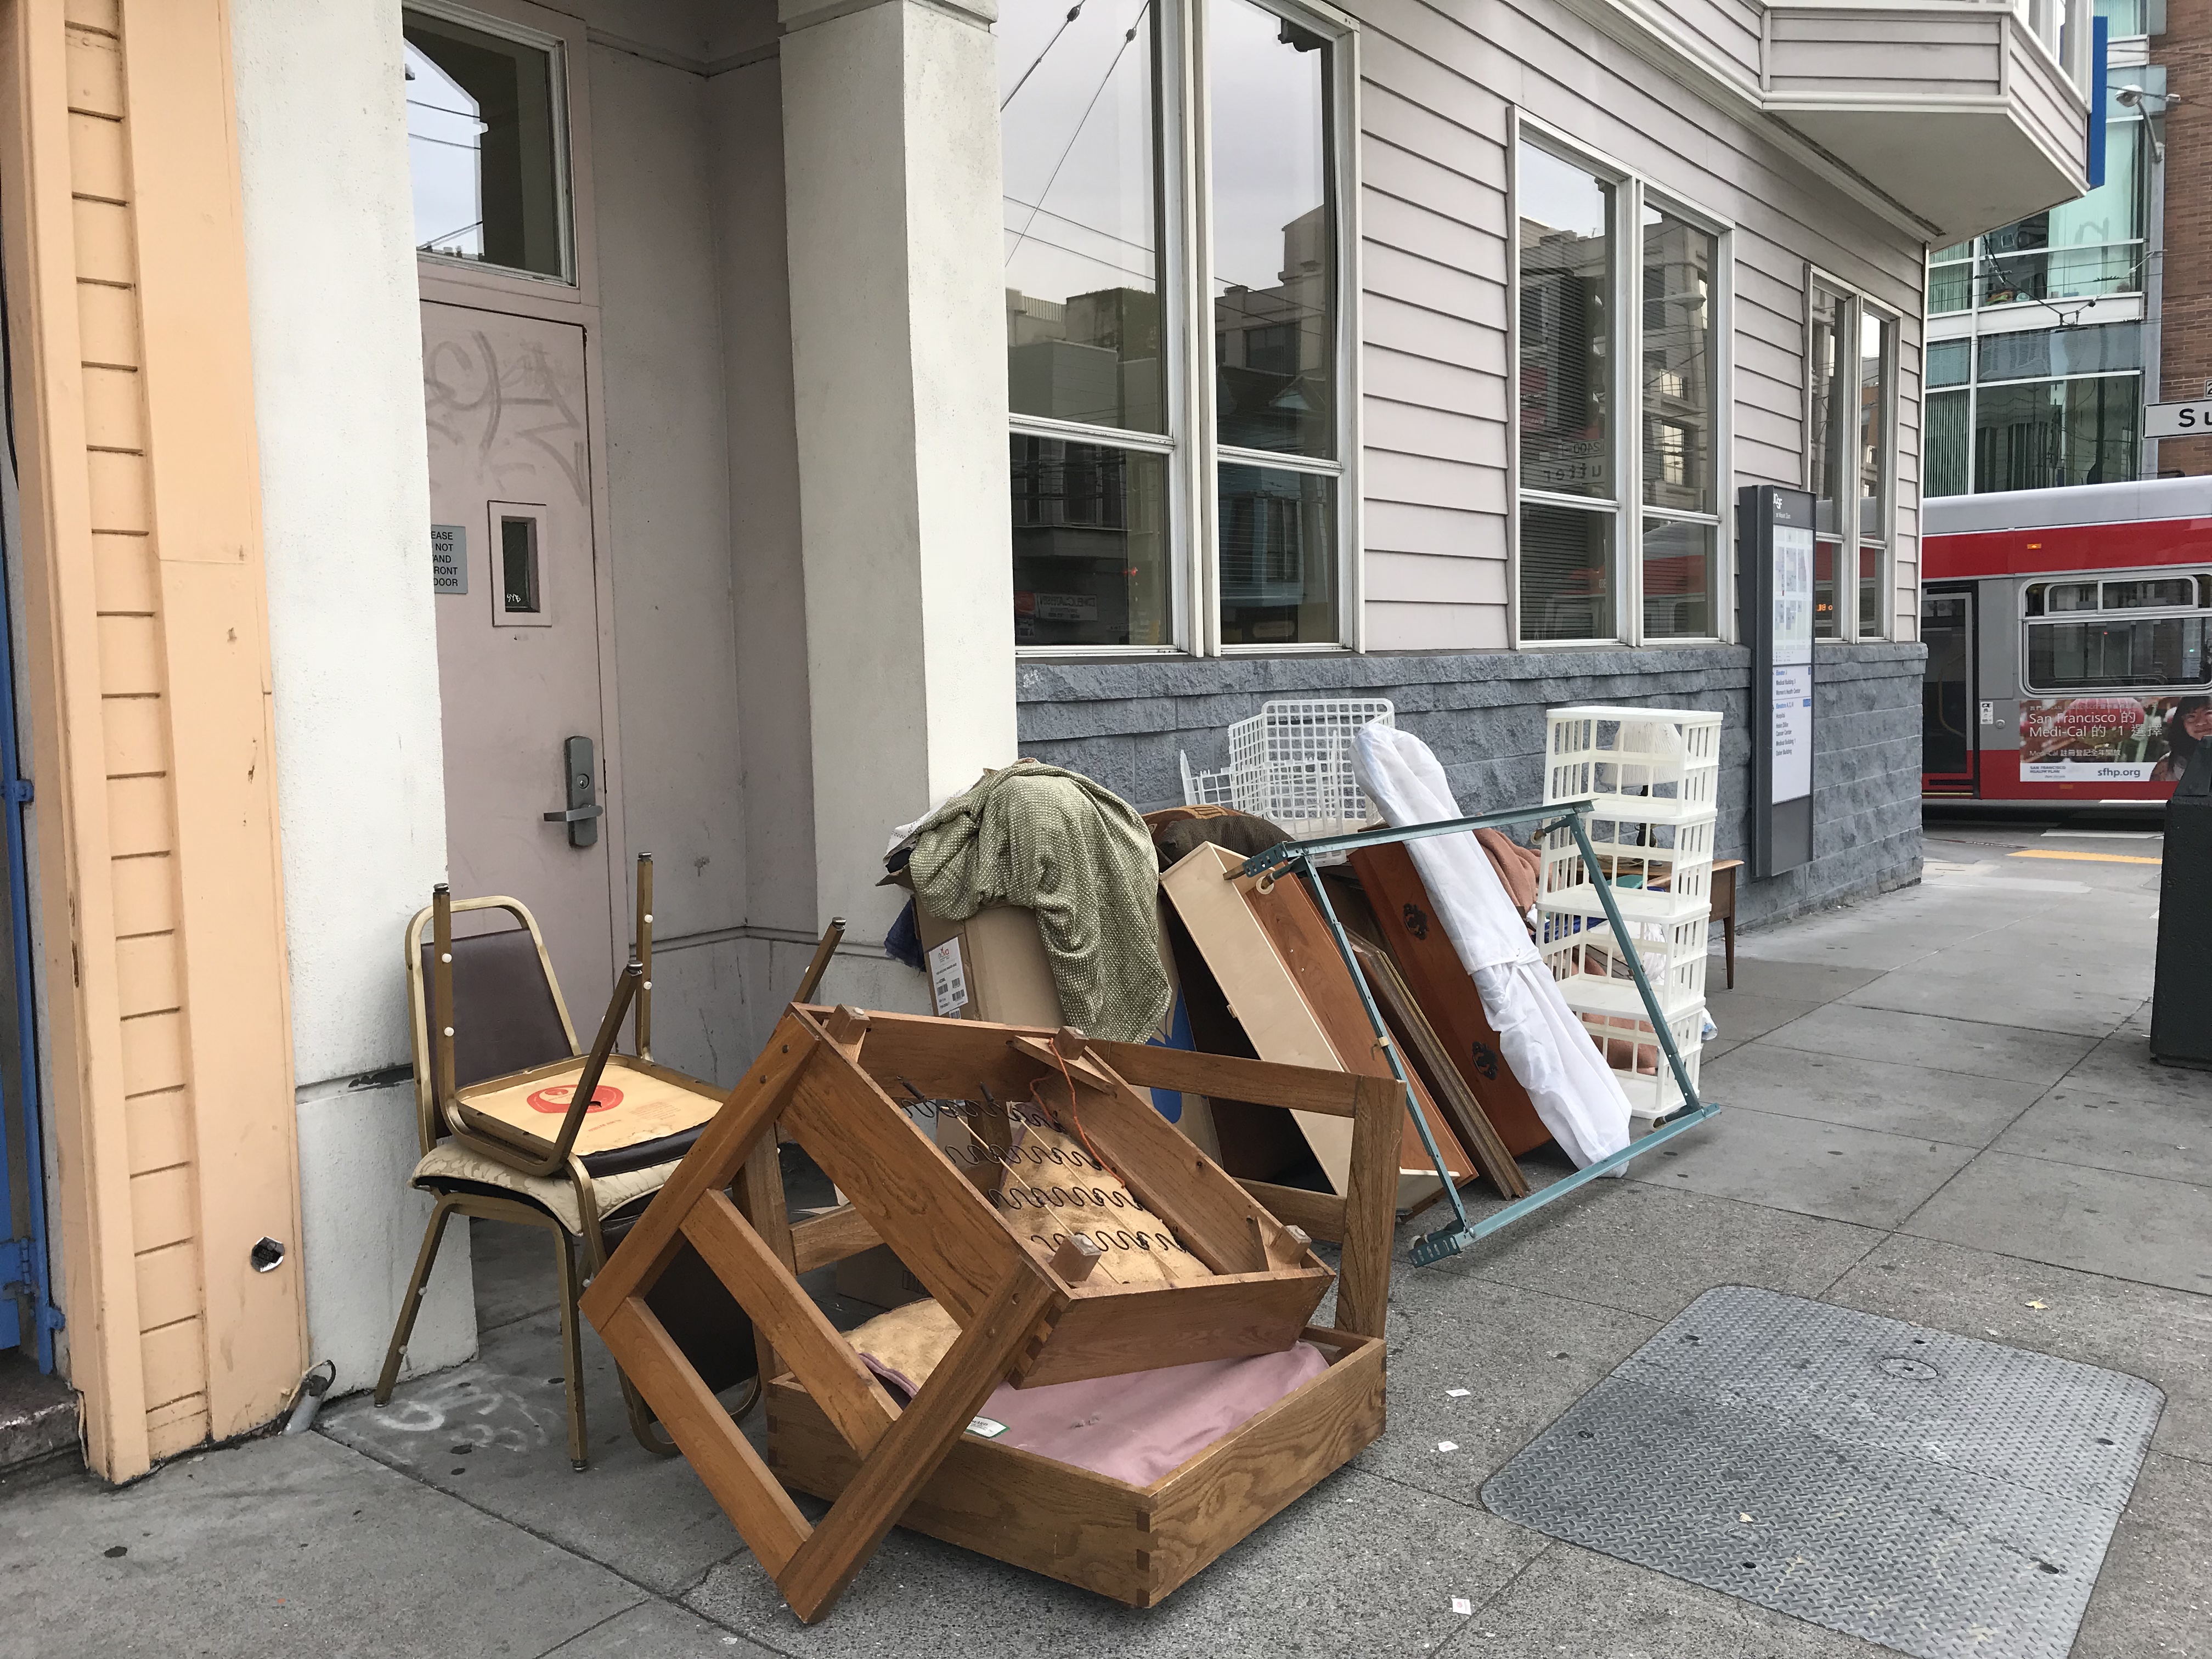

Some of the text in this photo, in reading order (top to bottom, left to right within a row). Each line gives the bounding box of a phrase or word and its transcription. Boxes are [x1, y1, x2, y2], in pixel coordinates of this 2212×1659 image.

[431, 531, 453, 540] EASE
[436, 543, 453, 551] NOT
[432, 554, 452, 563] AND
[434, 566, 458, 575] RONT
[433, 578, 458, 586] DOOR
[2029, 710, 2136, 724] San Francisco 的
[2030, 725, 2086, 737] Medi-Cal
[2091, 724, 2106, 737] 的
[2131, 724, 2162, 737] 選擇
[2097, 768, 2141, 777] sfhp.org
